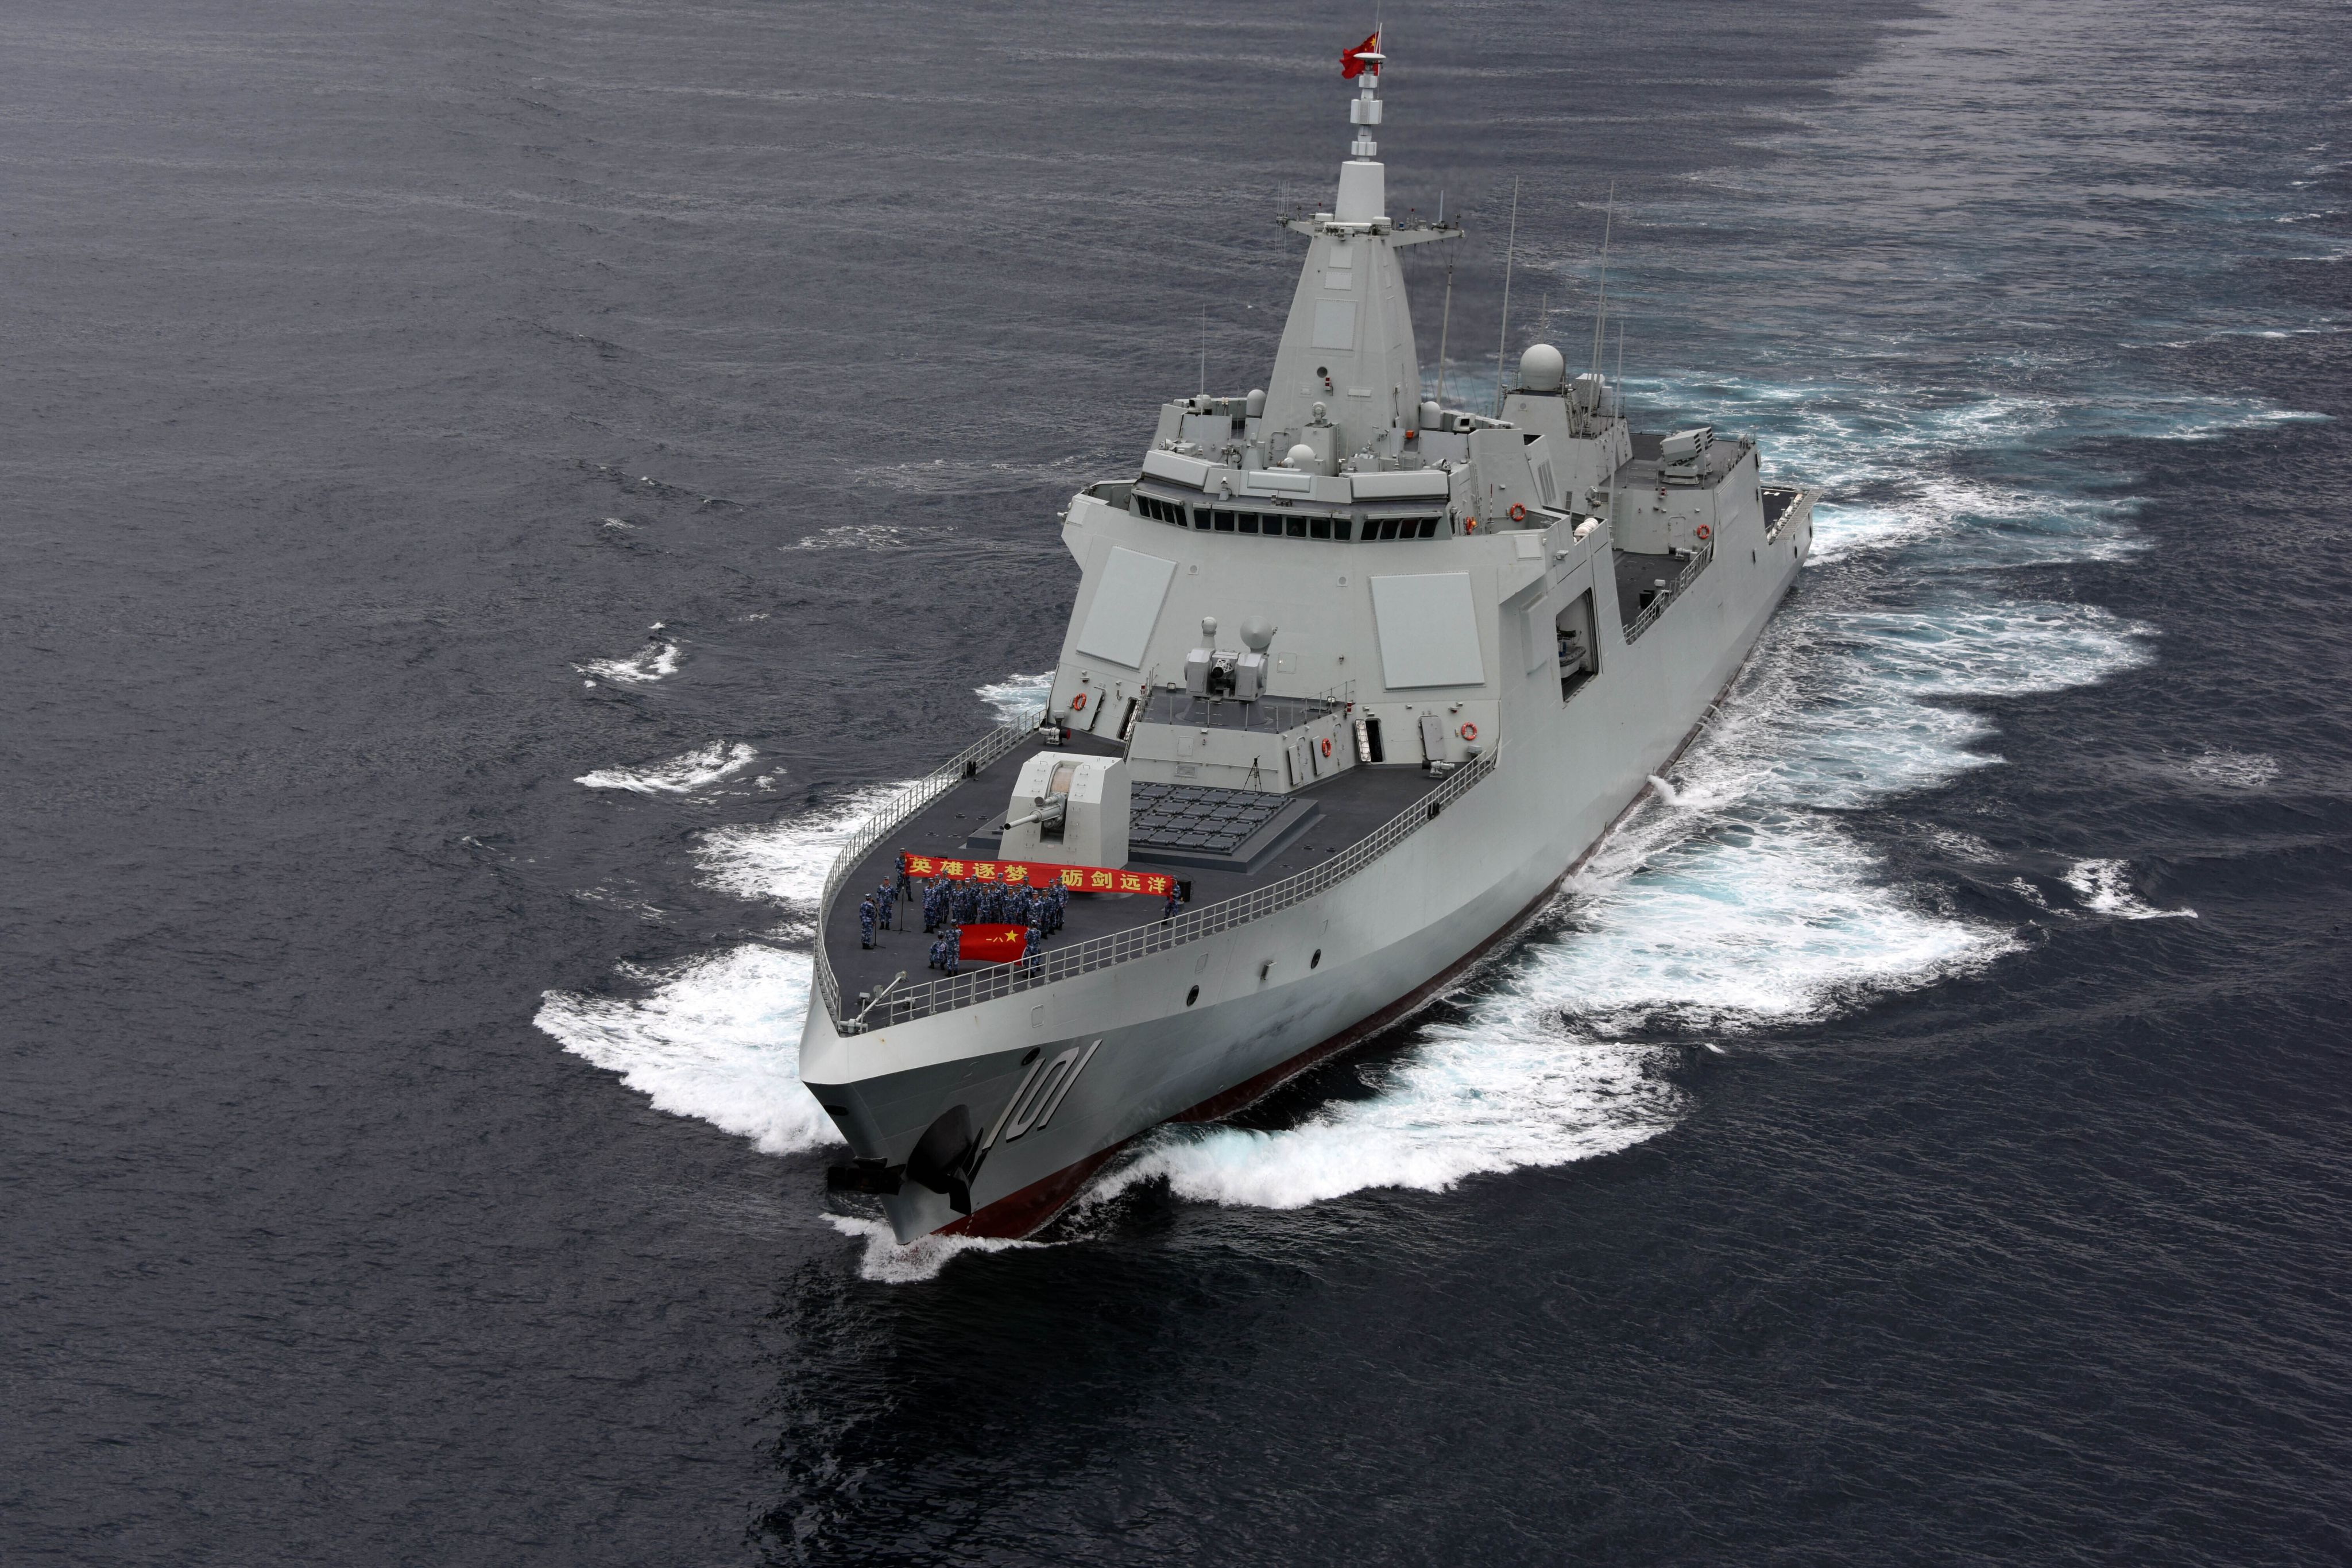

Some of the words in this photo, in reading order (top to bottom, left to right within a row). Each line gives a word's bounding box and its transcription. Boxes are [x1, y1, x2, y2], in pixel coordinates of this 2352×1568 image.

[909, 857, 1028, 881] 英雄逐梦
[1060, 869, 1166, 893] 砺剑远洋
[982, 1039, 1102, 1151] 101
